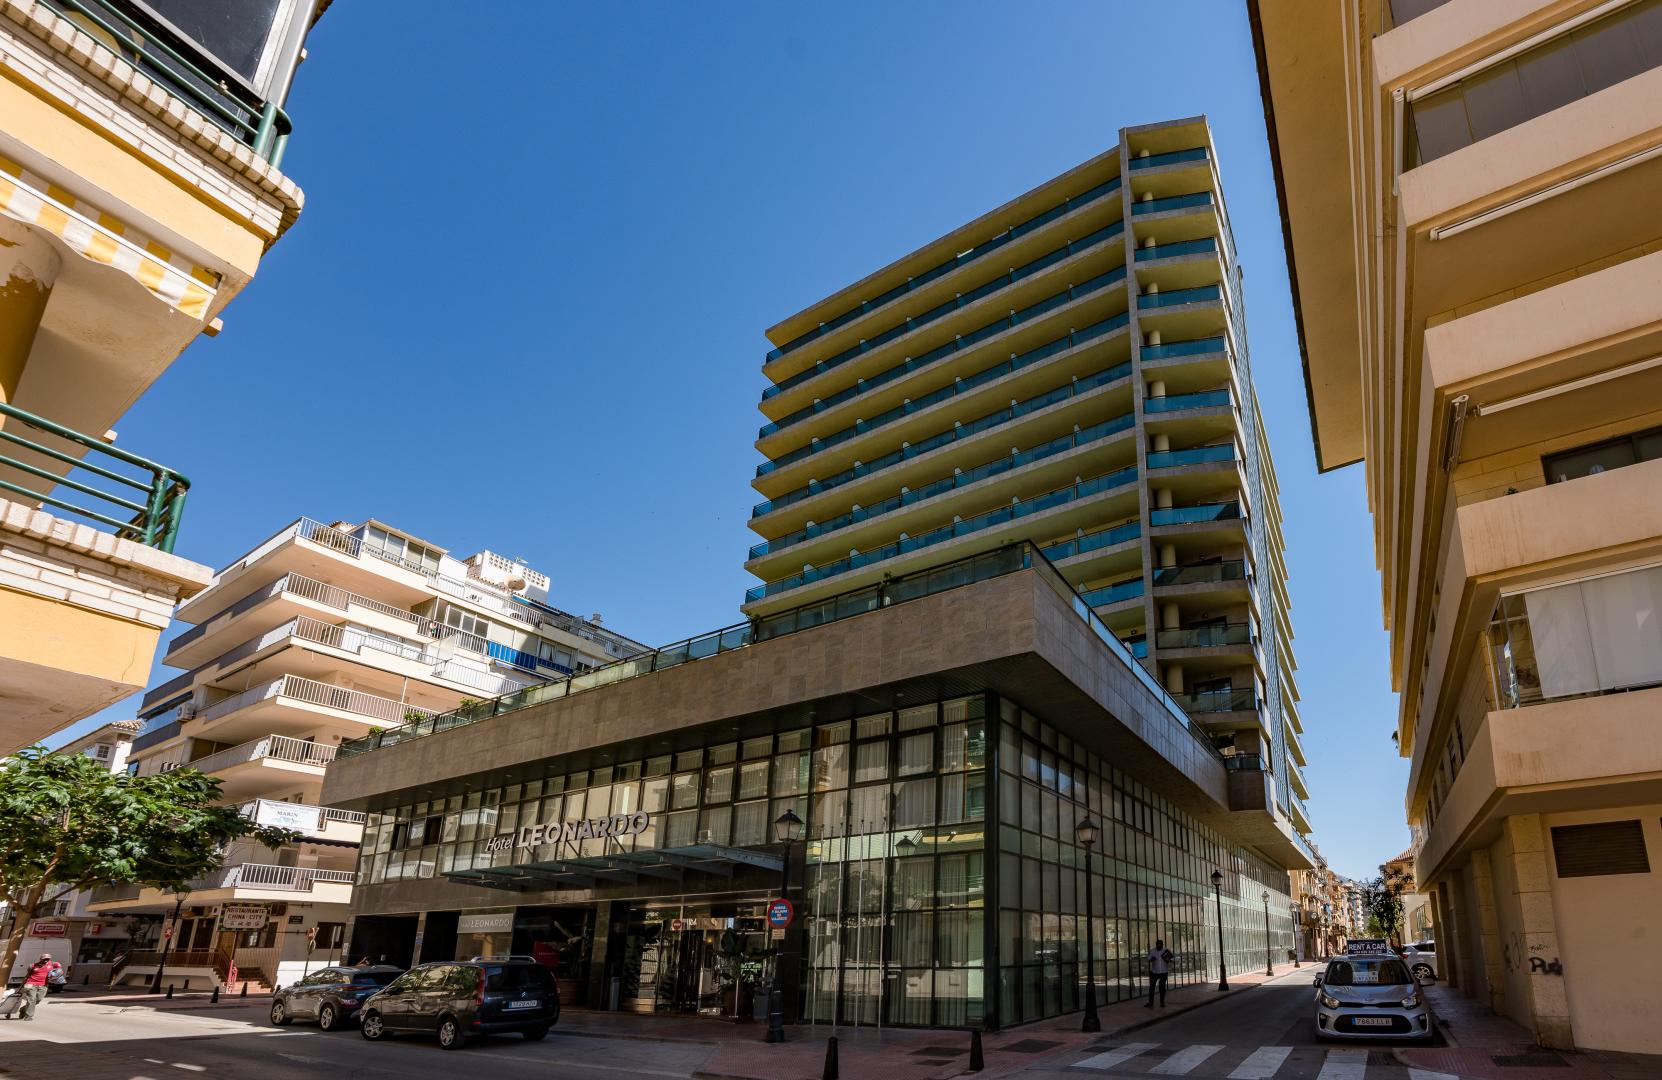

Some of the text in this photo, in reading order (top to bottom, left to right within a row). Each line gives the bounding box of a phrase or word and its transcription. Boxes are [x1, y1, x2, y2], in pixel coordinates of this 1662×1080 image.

[485, 810, 649, 852] Hotel LEONARDO
[471, 919, 510, 928] LEONARDO
